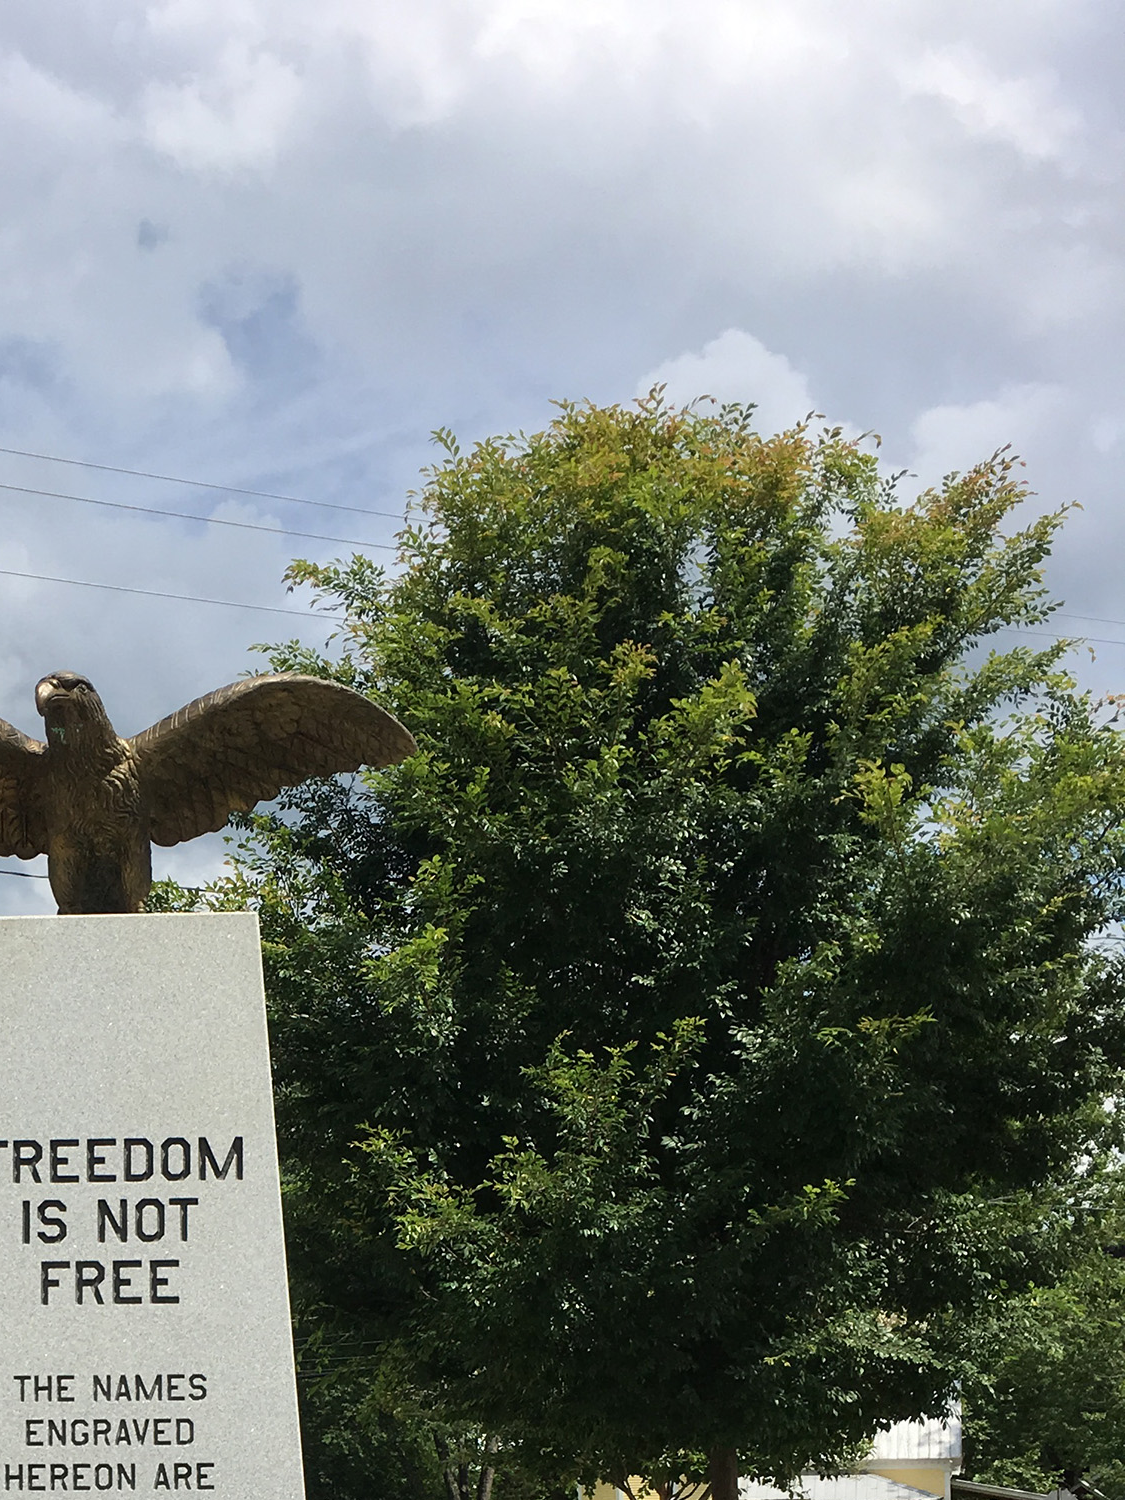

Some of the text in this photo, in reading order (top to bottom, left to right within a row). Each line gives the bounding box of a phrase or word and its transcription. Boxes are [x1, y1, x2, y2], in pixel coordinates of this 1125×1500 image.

[22, 1198, 199, 1244] IS NOT
[41, 1259, 180, 1305] FREE
[13, 1374, 207, 1402] THE NAMES
[26, 1418, 194, 1446] ENGRAVED
[5, 1463, 214, 1491] HEREON ARE
